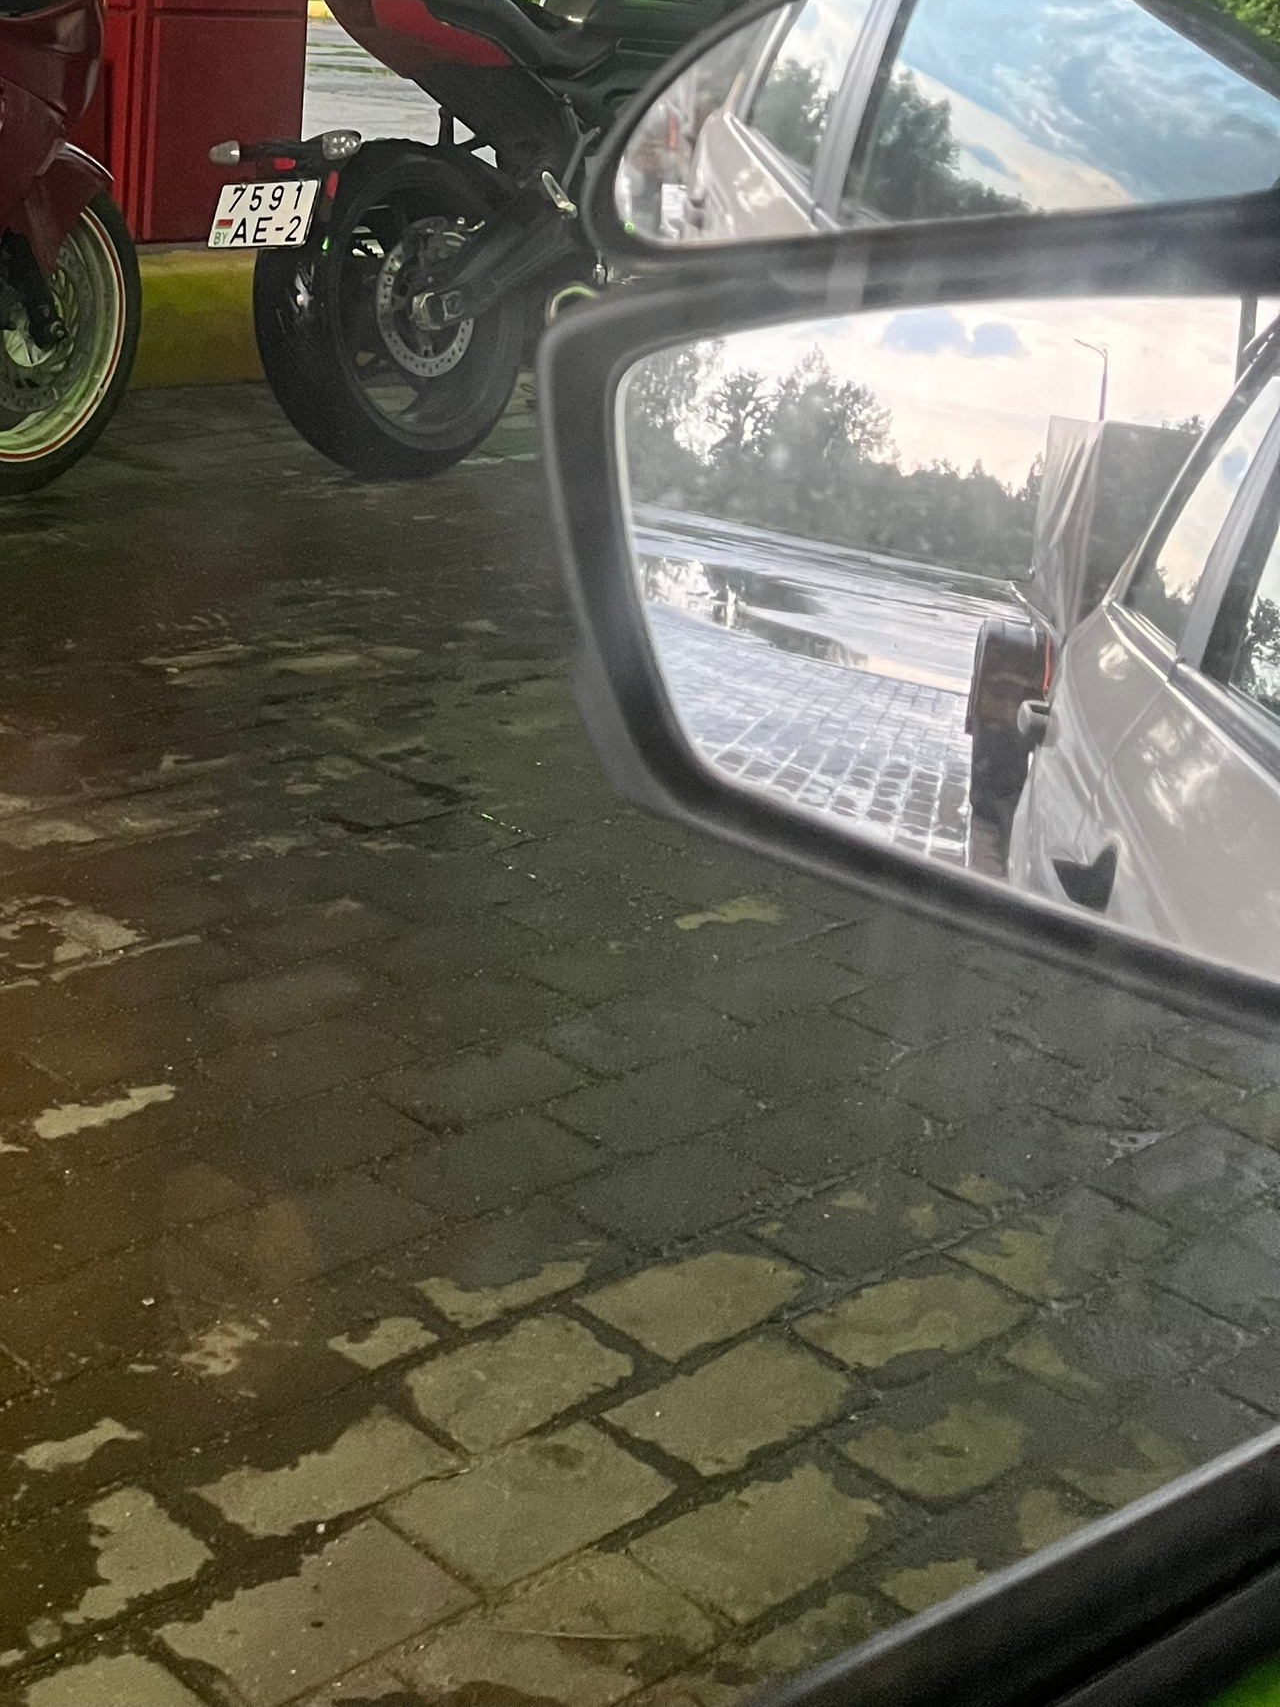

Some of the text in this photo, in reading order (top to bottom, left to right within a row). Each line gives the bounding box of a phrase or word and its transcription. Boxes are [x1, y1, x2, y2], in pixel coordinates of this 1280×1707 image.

[228, 185, 304, 213] 7591
[213, 215, 302, 246] BY AE-2
